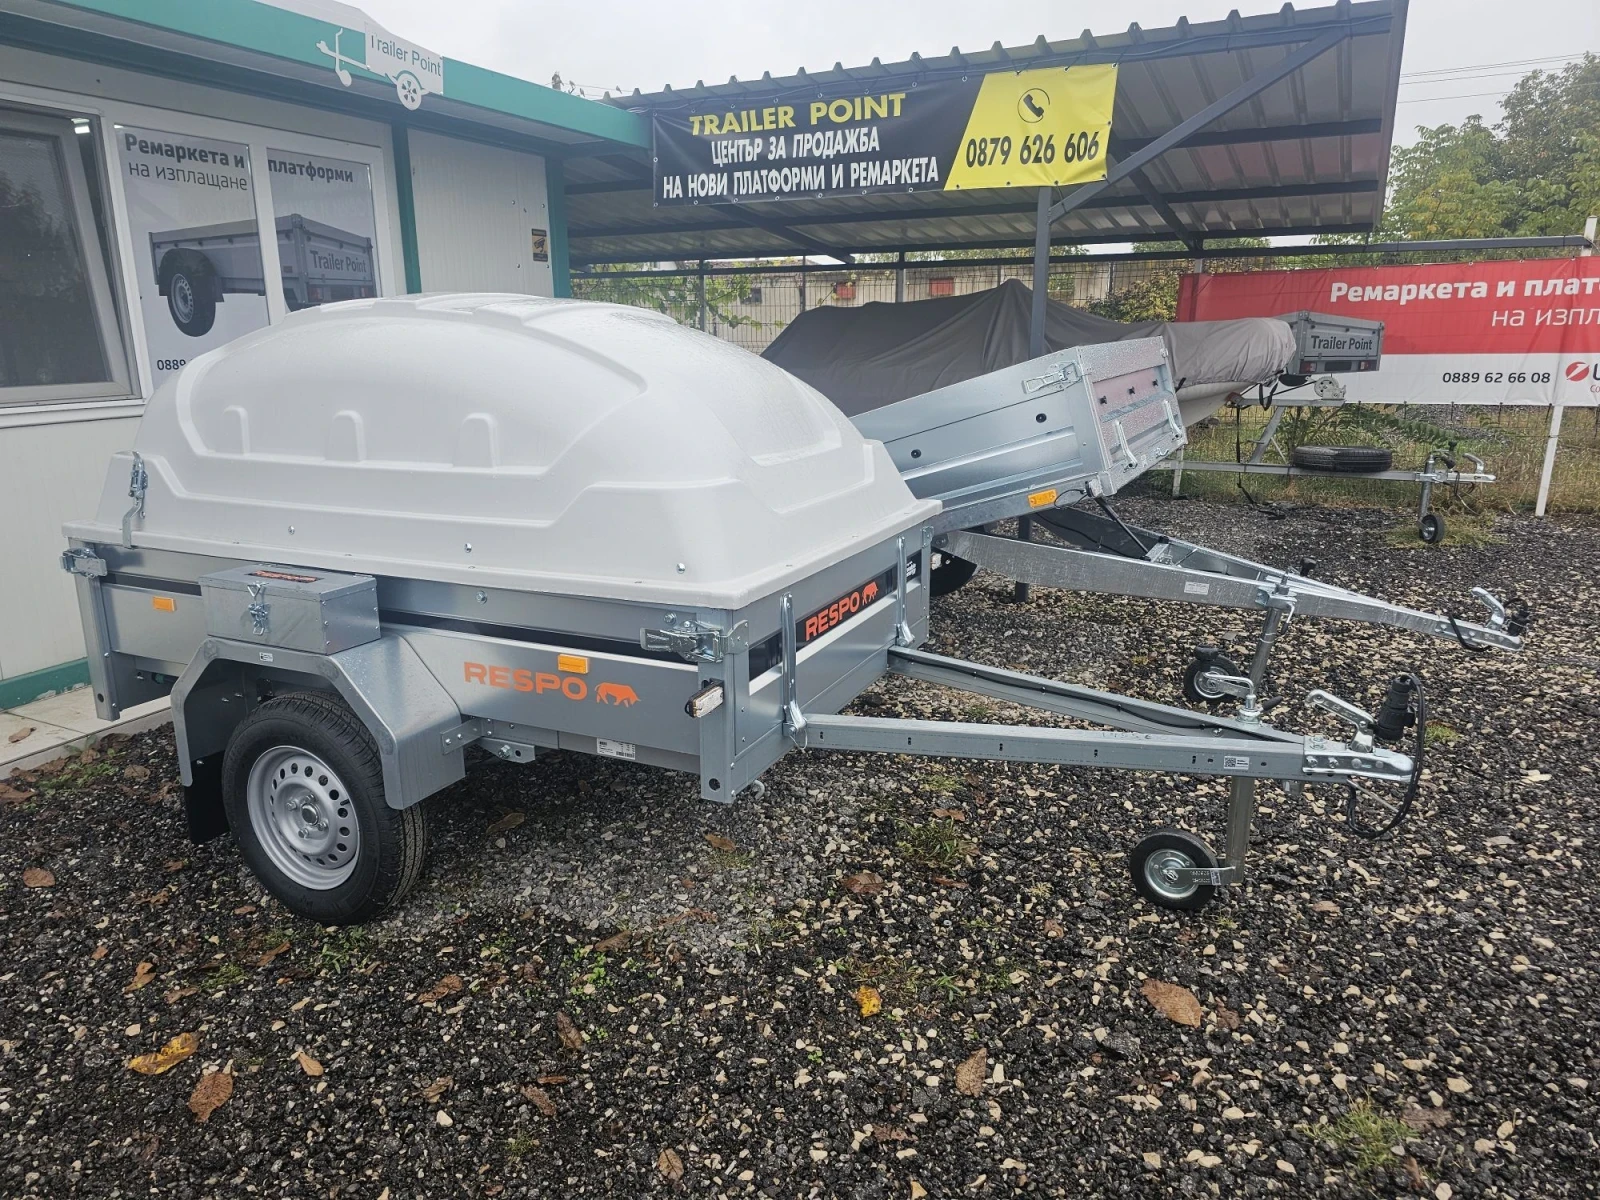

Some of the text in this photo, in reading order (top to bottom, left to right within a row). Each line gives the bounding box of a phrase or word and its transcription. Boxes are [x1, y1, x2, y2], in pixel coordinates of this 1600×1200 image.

[411, 49, 441, 77] Point
[689, 93, 906, 136] TRAILER POINT
[124, 132, 354, 184] Ремаркета и платформи
[711, 126, 880, 168] ЦЕНТЪР ЗА ПРОДАЖБА
[965, 131, 1100, 168] 0879 626 606
[128, 162, 248, 191] на изплащане
[663, 156, 939, 199] НА НОВИ ПЛАТФОРМИ И РЕМАРКЕТА
[310, 249, 367, 273] Trailer Point
[1330, 277, 1600, 306] Ремаркета и плат
[1491, 307, 1600, 327] на изпл
[1310, 335, 1373, 350] Trailer Point
[1442, 372, 1551, 384] 0889 62 66 08
[805, 591, 860, 642] RESPO
[463, 661, 588, 700] RESPO
